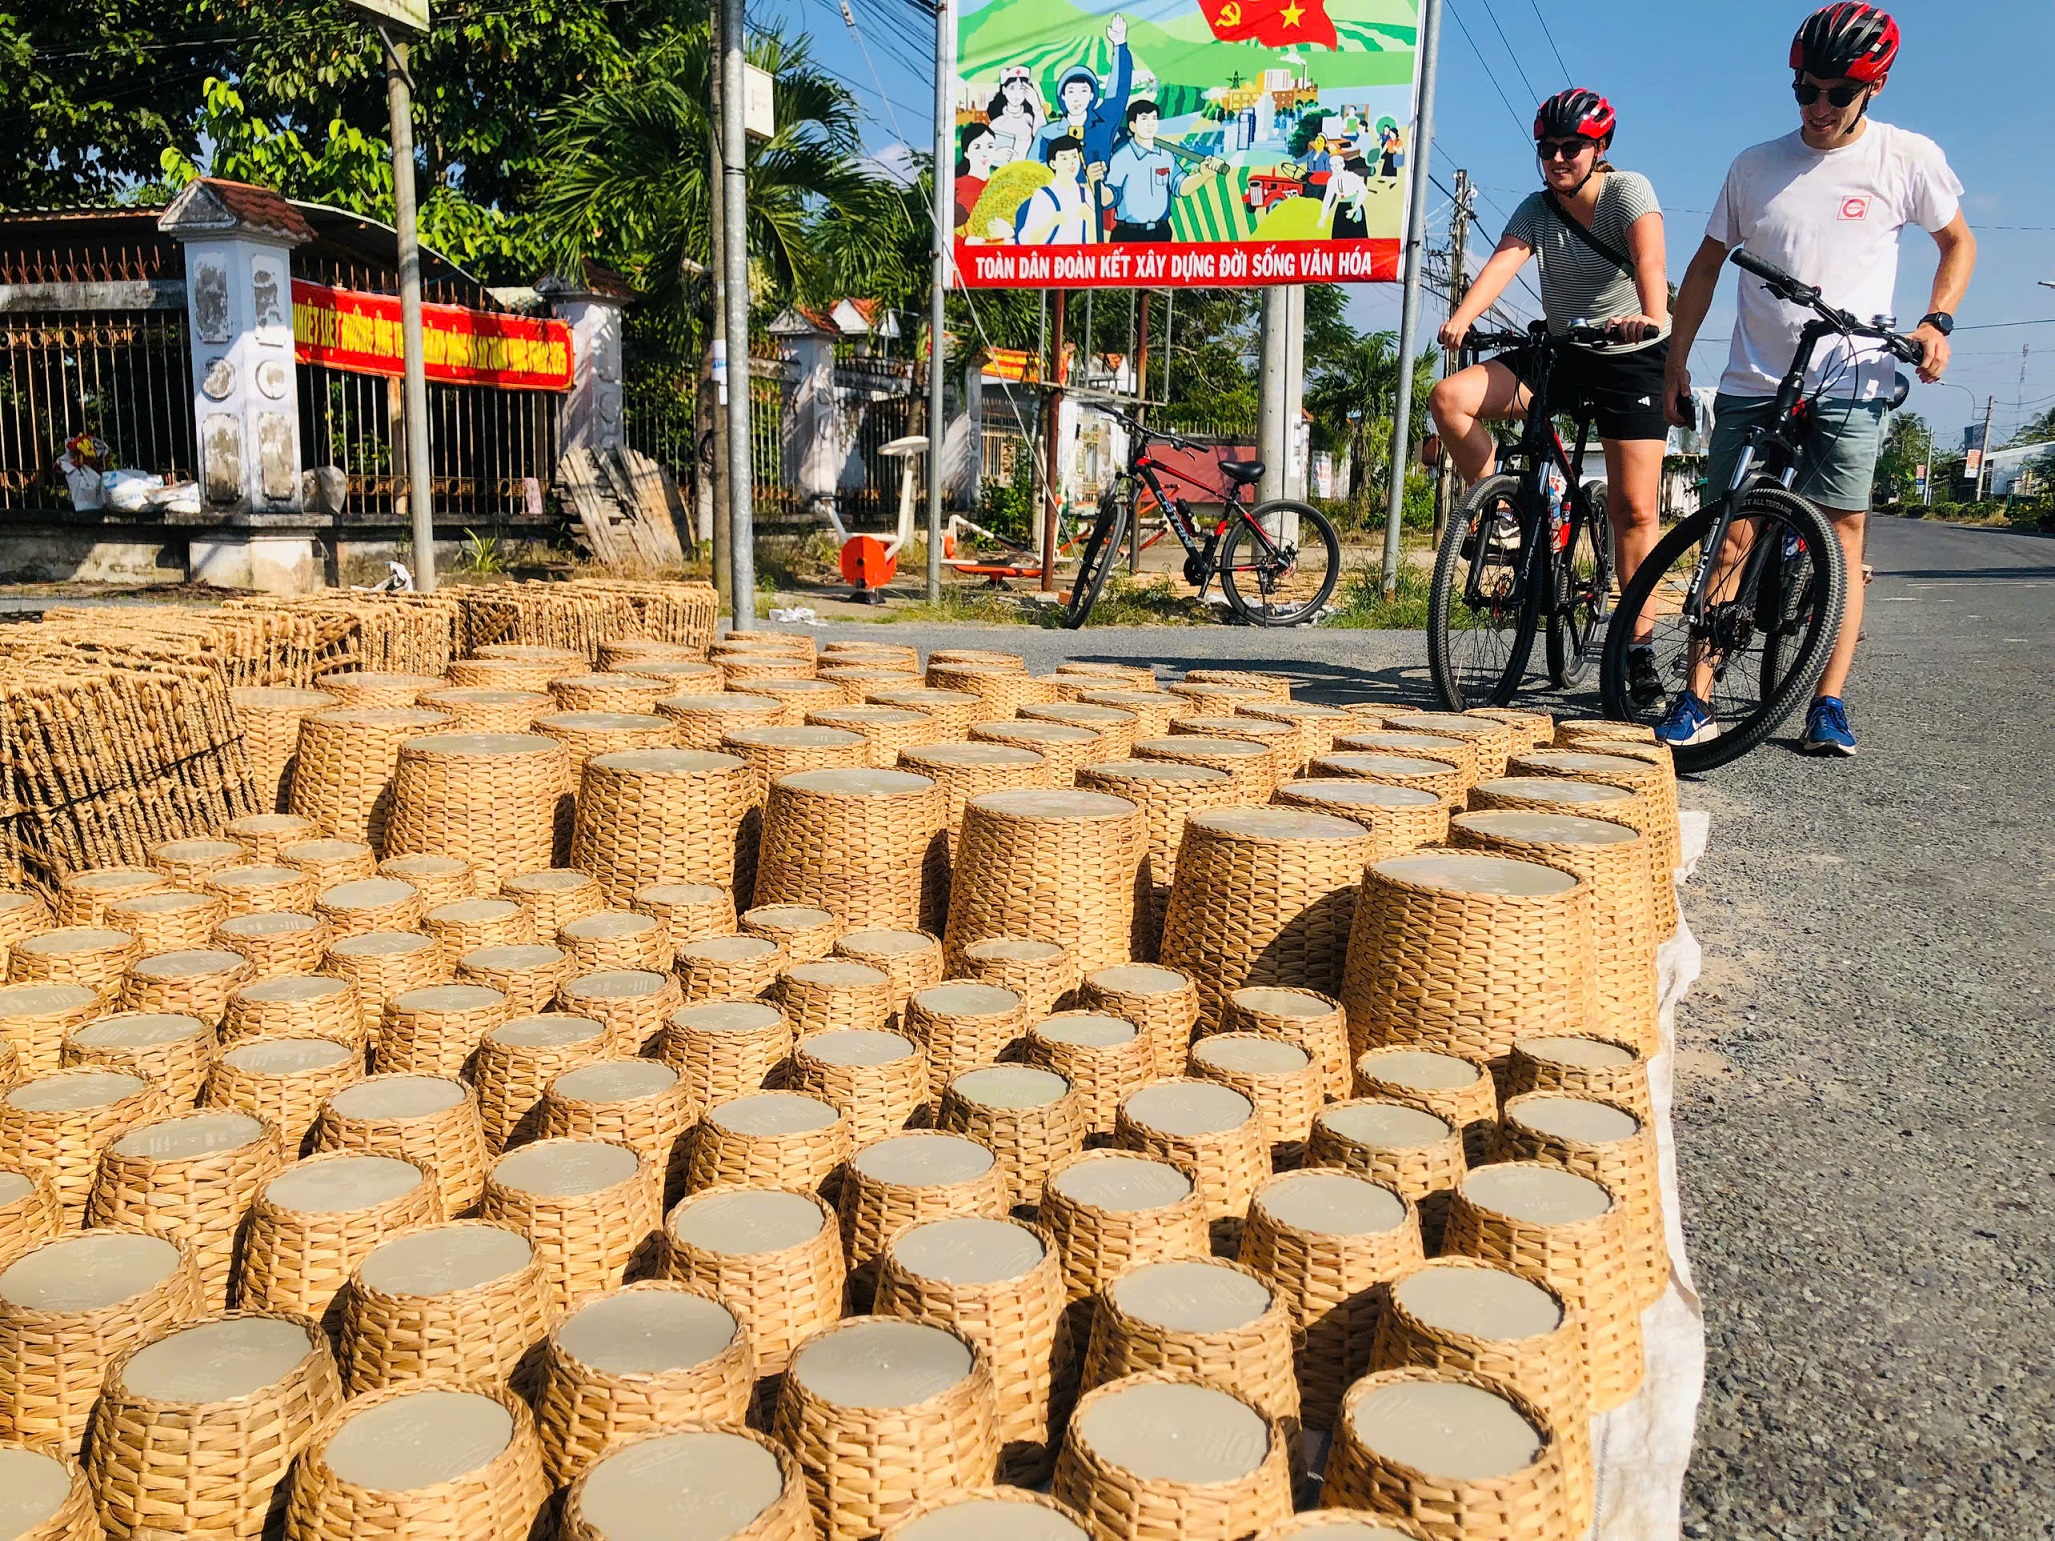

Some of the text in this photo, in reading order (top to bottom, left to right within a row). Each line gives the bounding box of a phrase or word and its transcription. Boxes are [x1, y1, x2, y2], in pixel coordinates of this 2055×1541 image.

[975, 244, 1372, 282] TOÀN DÂN ĐOÀN KẾT XÂY DỰNG ĐỜI SỐNG VĂN HÓA
